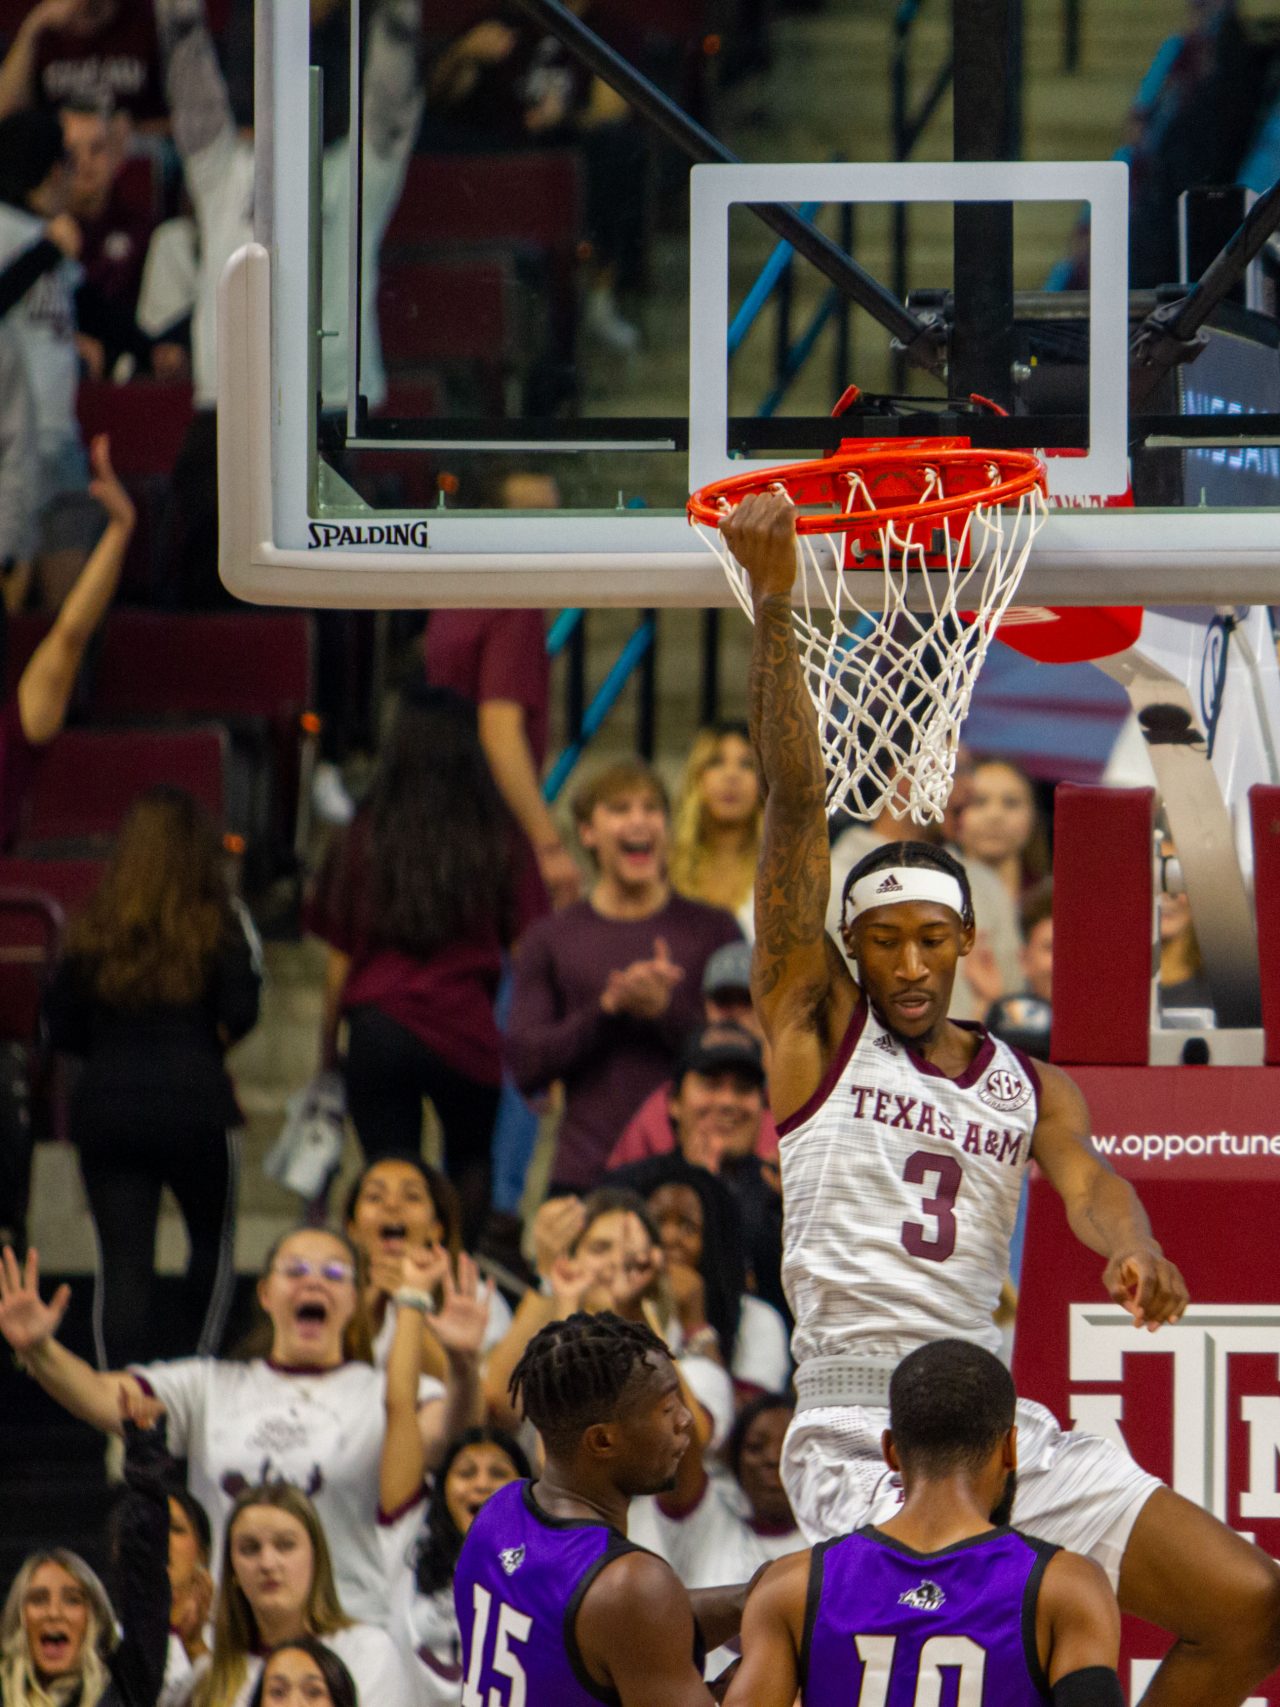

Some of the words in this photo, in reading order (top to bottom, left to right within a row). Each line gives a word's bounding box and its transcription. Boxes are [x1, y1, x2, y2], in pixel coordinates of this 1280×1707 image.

[308, 521, 428, 549] SPALDING
[988, 1069, 1022, 1101] SEC
[851, 1085, 955, 1141] TEXAS
[962, 1120, 1025, 1167] A&M
[901, 1151, 963, 1263] 3
[462, 1583, 533, 1707] 15
[854, 1634, 986, 1707] 10
